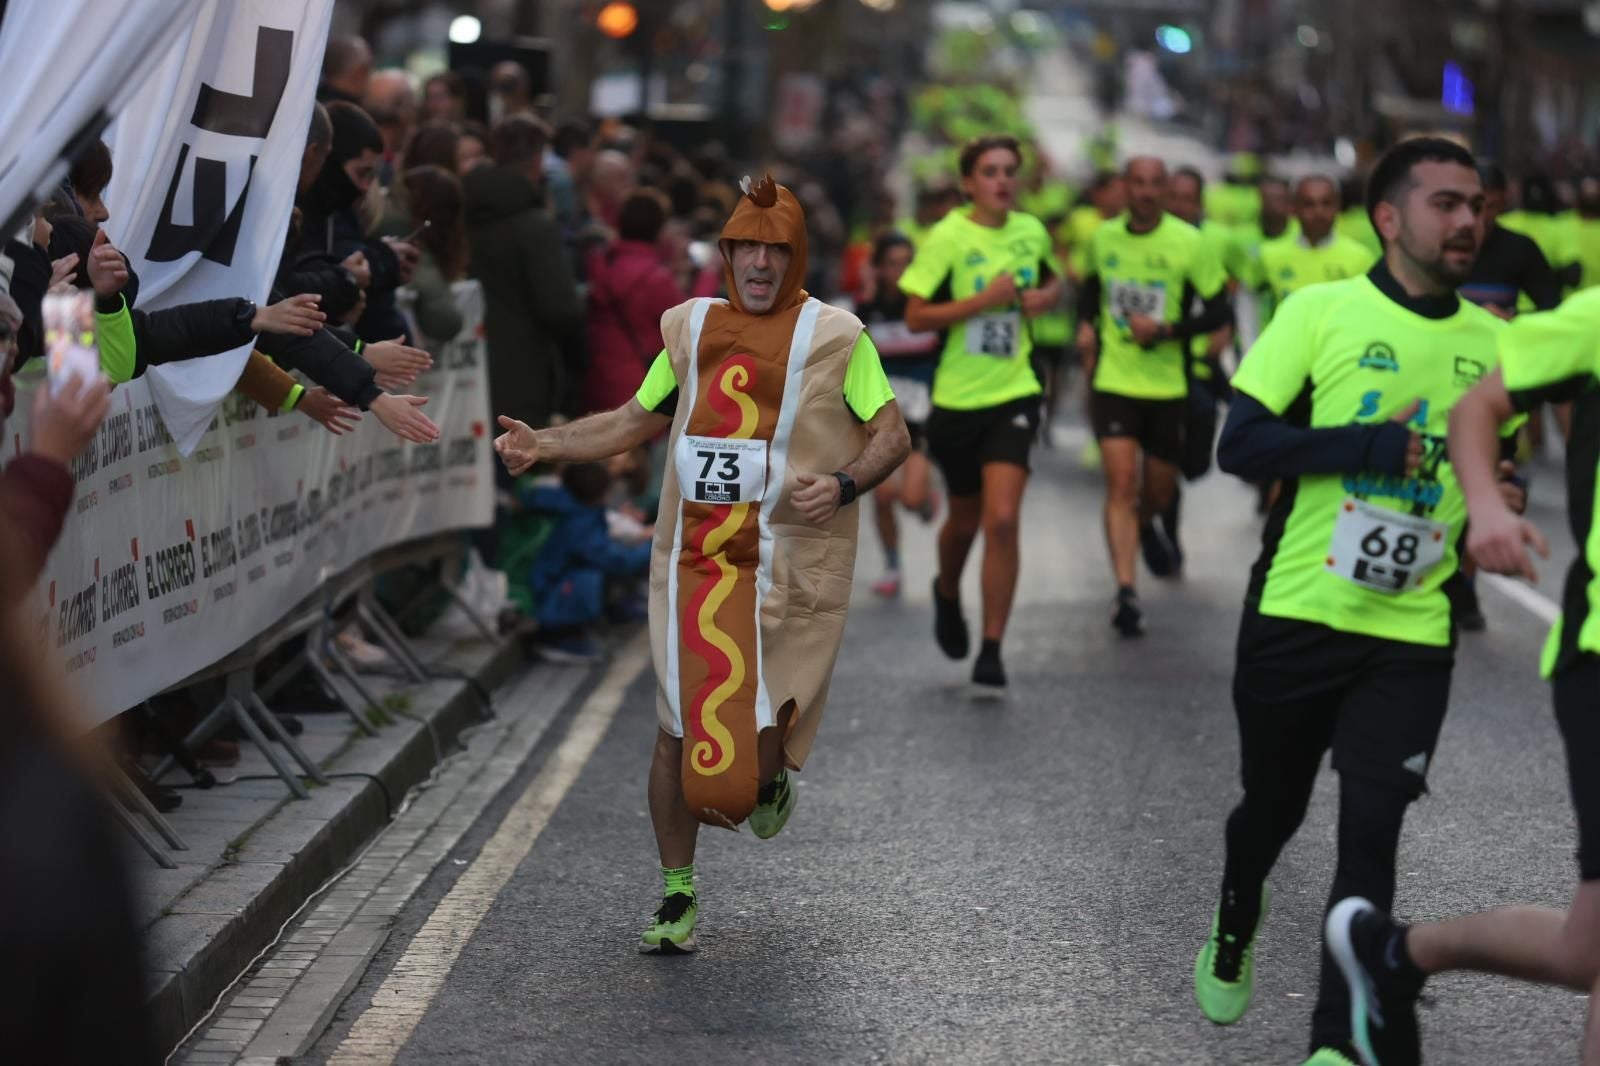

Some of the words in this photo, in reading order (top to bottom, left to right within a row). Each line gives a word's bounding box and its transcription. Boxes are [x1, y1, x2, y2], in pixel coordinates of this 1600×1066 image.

[697, 450, 740, 481] 73
[145, 554, 160, 600] EL
[156, 540, 196, 595] CORREO
[1361, 525, 1420, 566] 68
[102, 575, 112, 624] EL
[110, 562, 140, 618] CORREO
